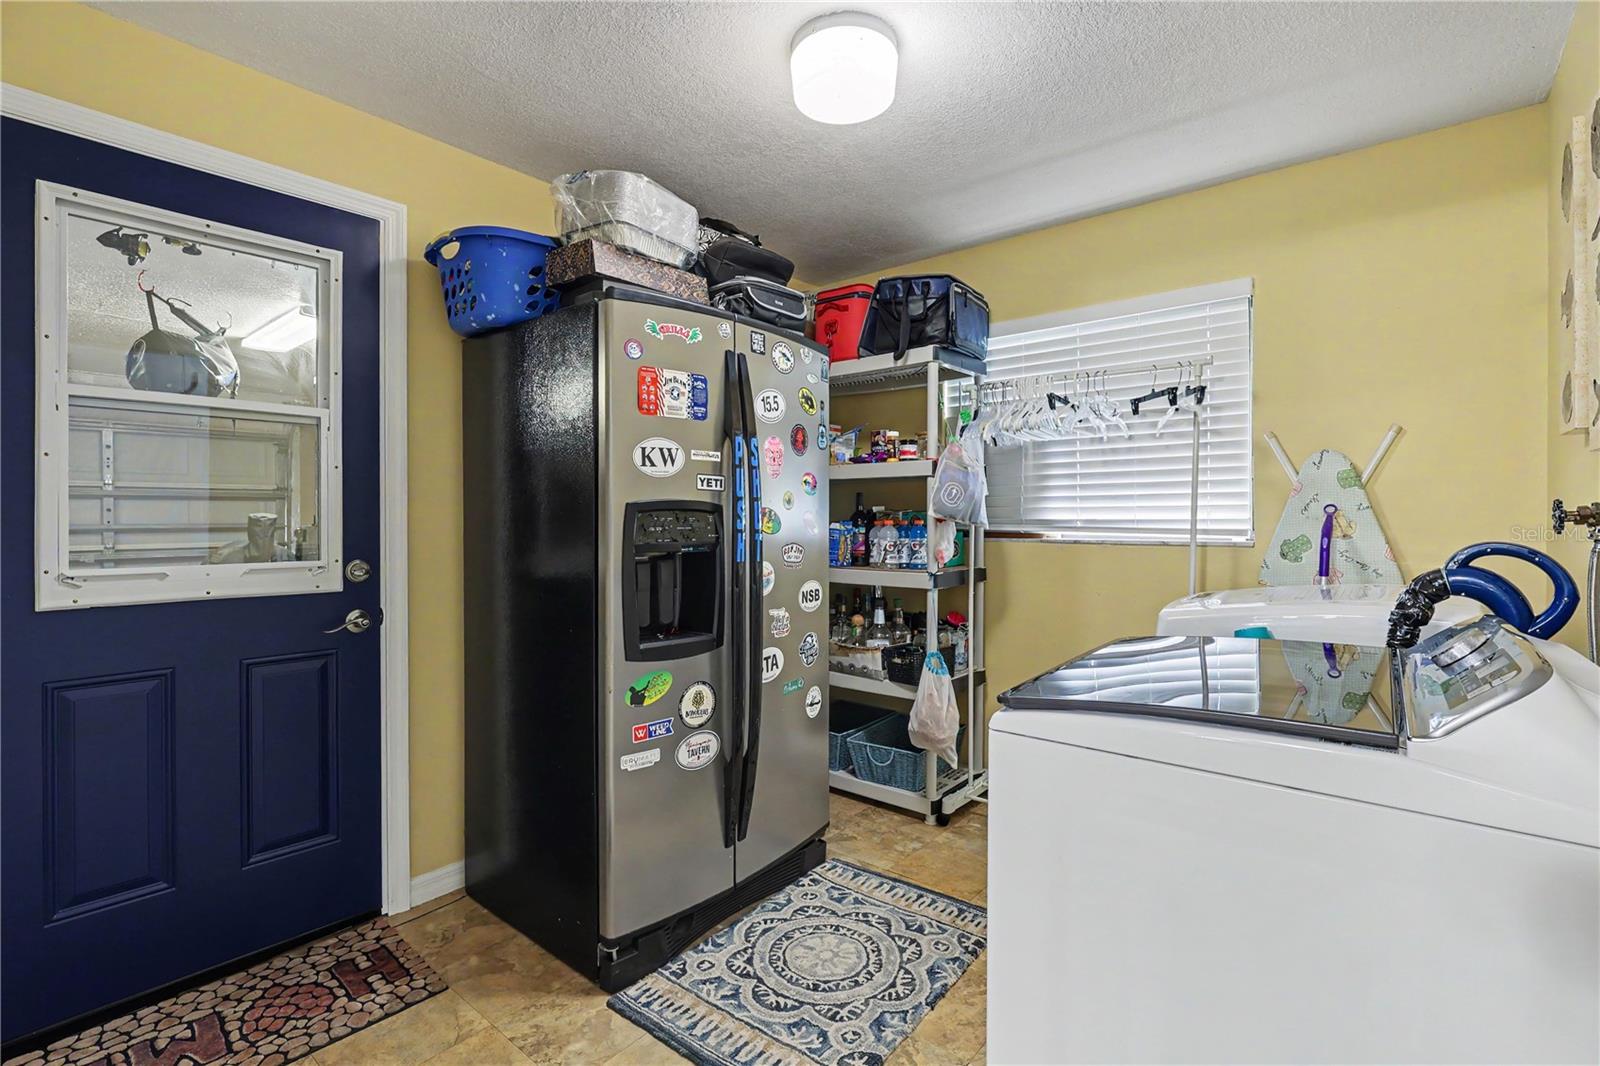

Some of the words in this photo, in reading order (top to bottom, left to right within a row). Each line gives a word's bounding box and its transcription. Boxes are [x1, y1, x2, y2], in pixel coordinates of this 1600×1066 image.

[761, 395, 779, 412] 15.5
[640, 446, 679, 467] KW
[698, 476, 723, 489] YETI
[735, 436, 746, 562] PUSH
[801, 588, 820, 604] NSB
[761, 653, 779, 673] TA
[687, 744, 711, 760] TAVERN
